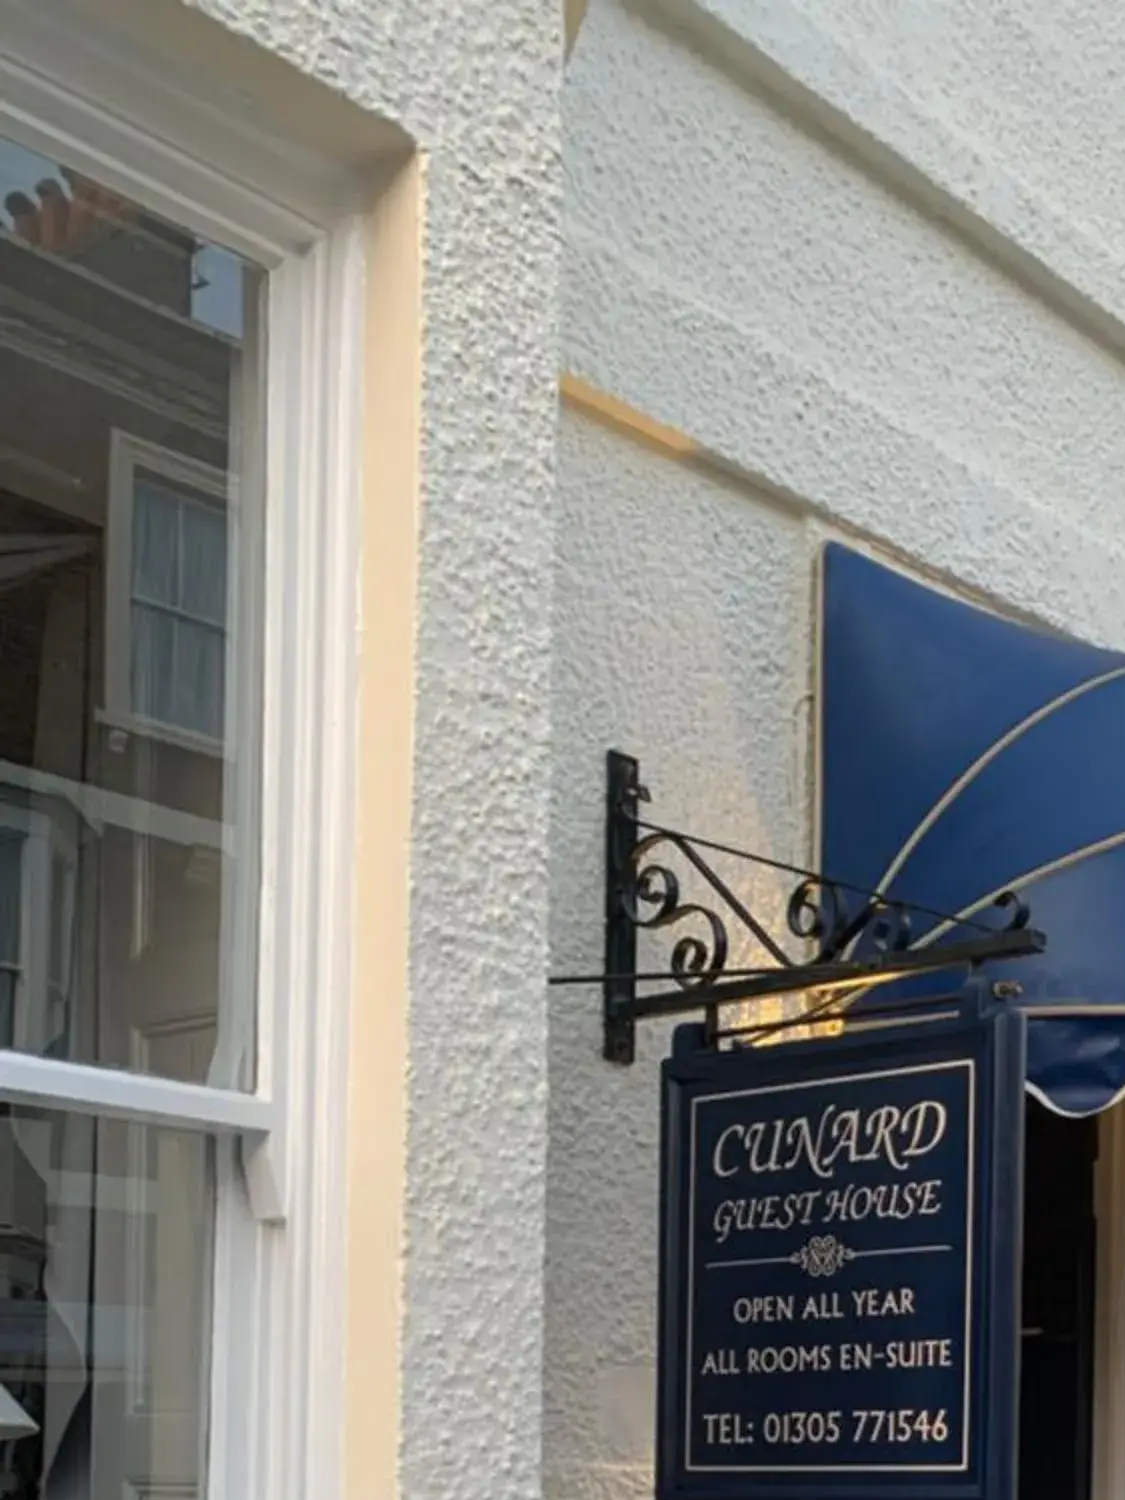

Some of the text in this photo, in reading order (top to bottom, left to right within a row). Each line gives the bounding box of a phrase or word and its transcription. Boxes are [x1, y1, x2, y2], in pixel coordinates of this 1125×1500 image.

[713, 1100, 947, 1178] CUNARD
[713, 1180, 942, 1243] GUEST HOUSE
[733, 1288, 916, 1324] OPEN ALL YEAR
[701, 1338, 952, 1375] ALL ROOMS EN-SUITE
[703, 1409, 949, 1444] TEL: 01305 771546
